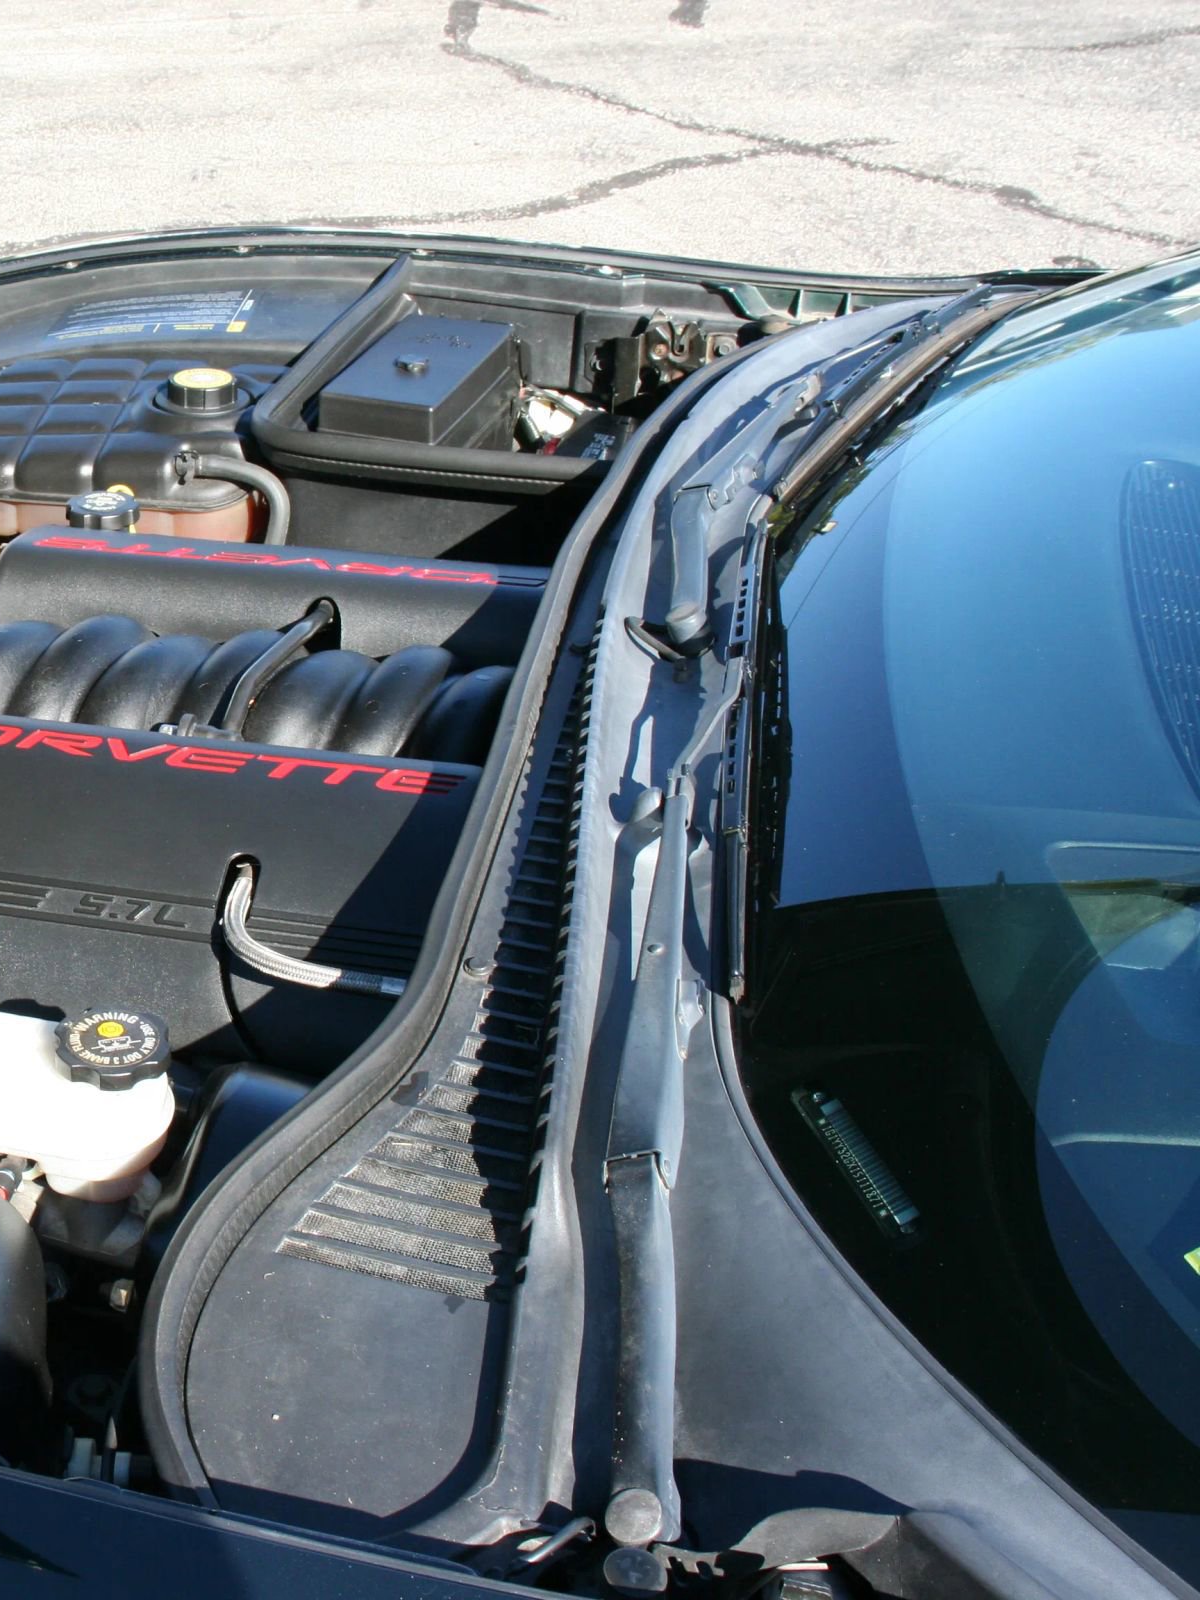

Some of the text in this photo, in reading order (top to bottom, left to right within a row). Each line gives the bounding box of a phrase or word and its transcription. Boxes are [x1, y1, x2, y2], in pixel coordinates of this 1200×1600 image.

[72, 892, 192, 929] 5.7L
[73, 1012, 139, 1032] WARNING
[69, 1032, 84, 1052] FLUID
[141, 1037, 156, 1054] ONLY
[78, 1049, 110, 1064] BRAKE
[112, 1055, 120, 1064] 3
[122, 1050, 142, 1063] DOT
